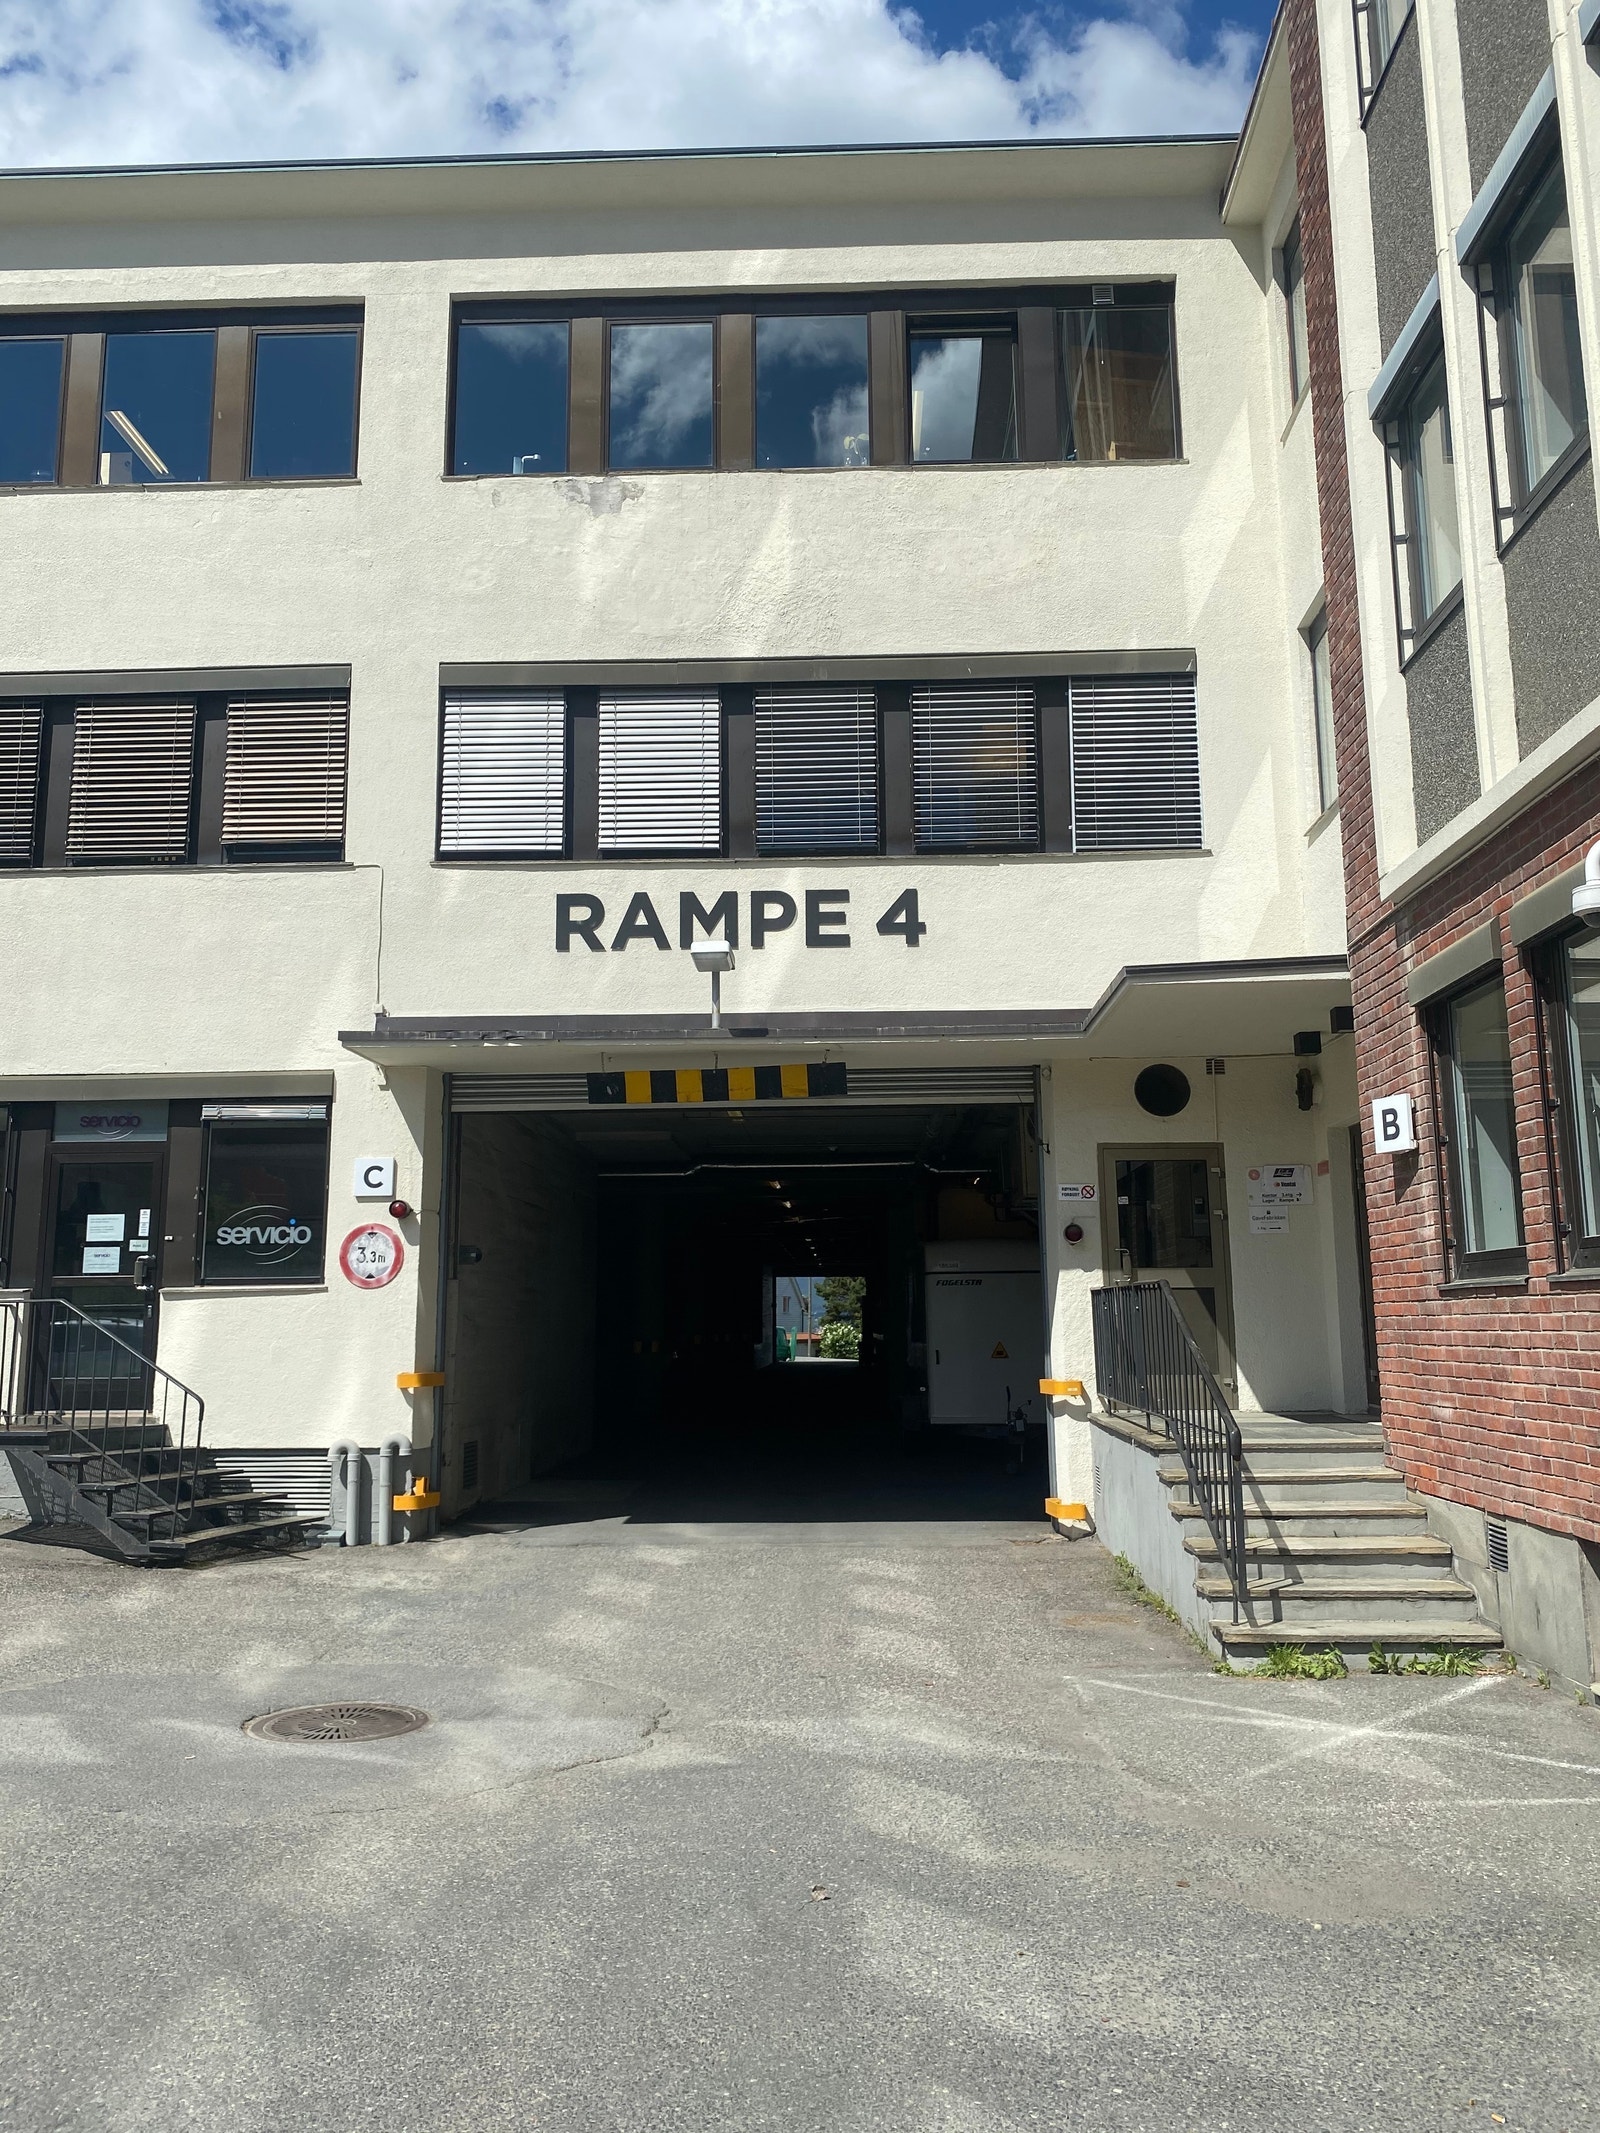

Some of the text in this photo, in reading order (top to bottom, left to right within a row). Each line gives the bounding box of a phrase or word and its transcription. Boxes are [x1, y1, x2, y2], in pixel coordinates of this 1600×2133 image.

[556, 888, 927, 952] RAMPE 4
[80, 1114, 142, 1128] servicio
[1381, 1107, 1400, 1142] B
[363, 1165, 384, 1189] C
[216, 1218, 312, 1245] servicio
[936, 1279, 983, 1287] FOGELSTA
